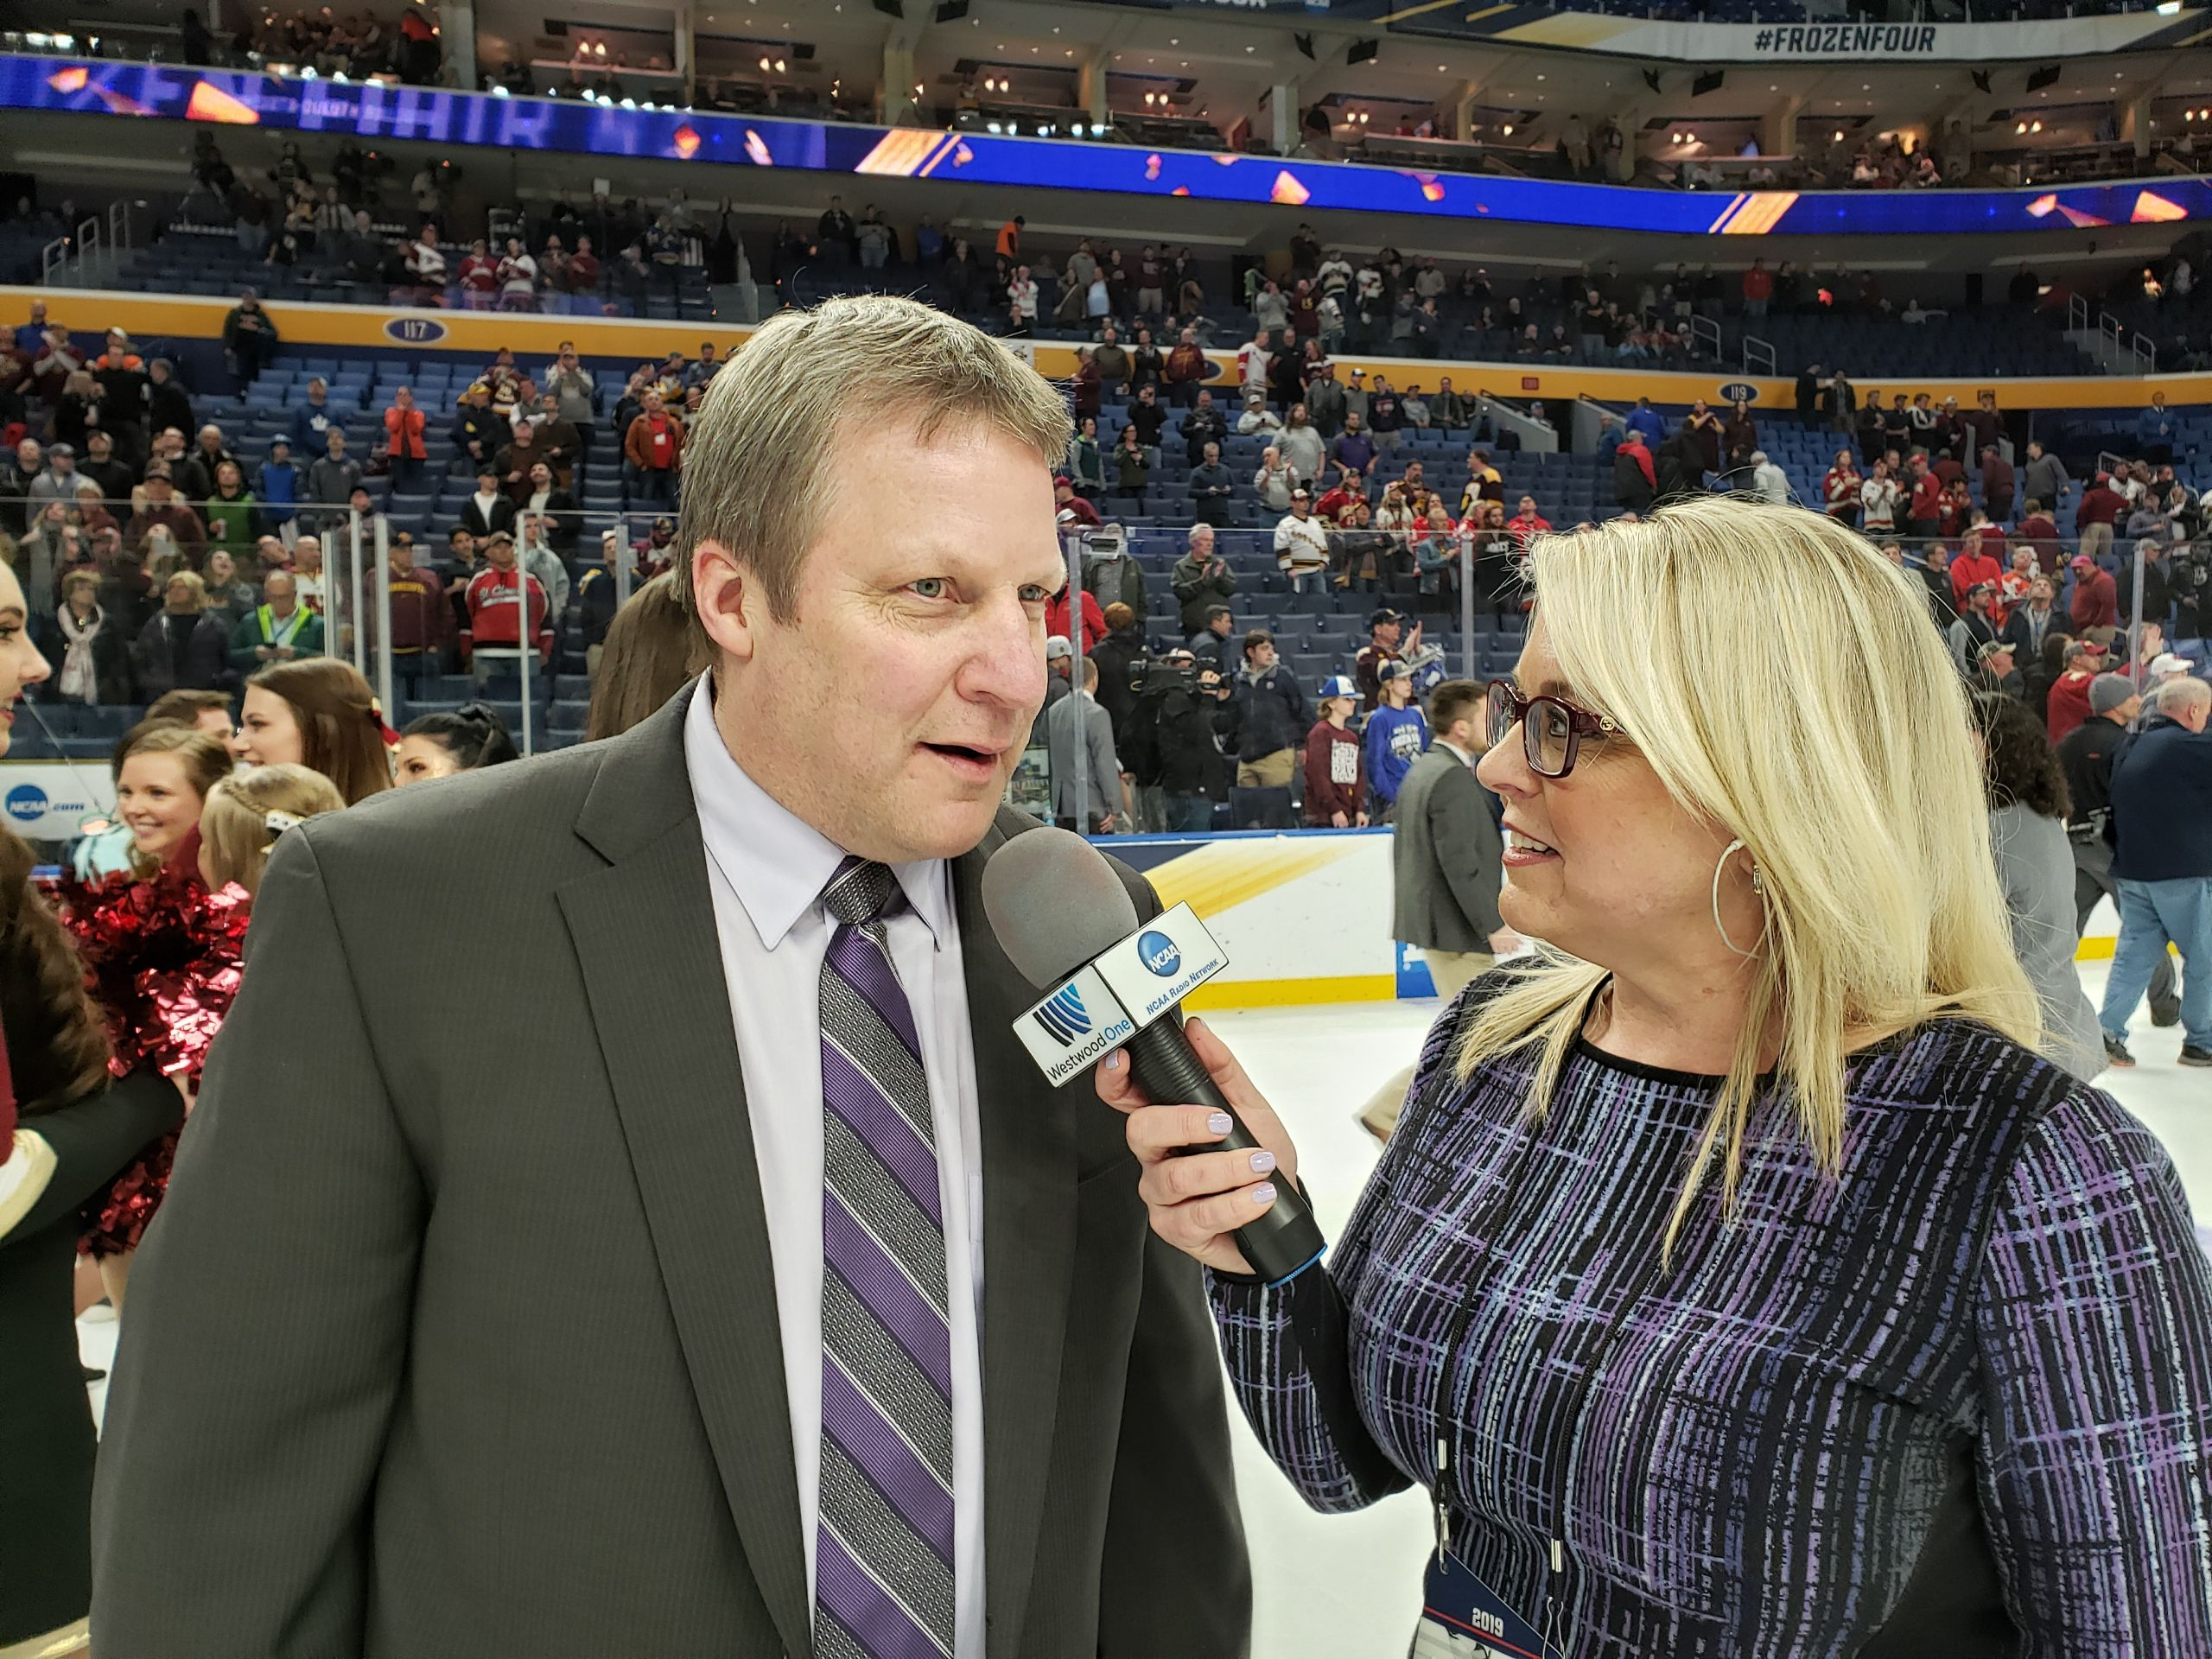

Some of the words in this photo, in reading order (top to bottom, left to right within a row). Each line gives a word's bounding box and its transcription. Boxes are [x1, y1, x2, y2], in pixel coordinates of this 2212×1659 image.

[1755, 26, 1936, 52] #FROZENFOUR
[405, 321, 427, 339] 117
[1731, 385, 1747, 401] 119
[1147, 944, 1180, 973] NCAA
[1146, 994, 1170, 1015] NCAA
[1046, 1033, 1108, 1080] Westwood
[1104, 1020, 1131, 1040] One
[1472, 1607, 1504, 1637] 2019
